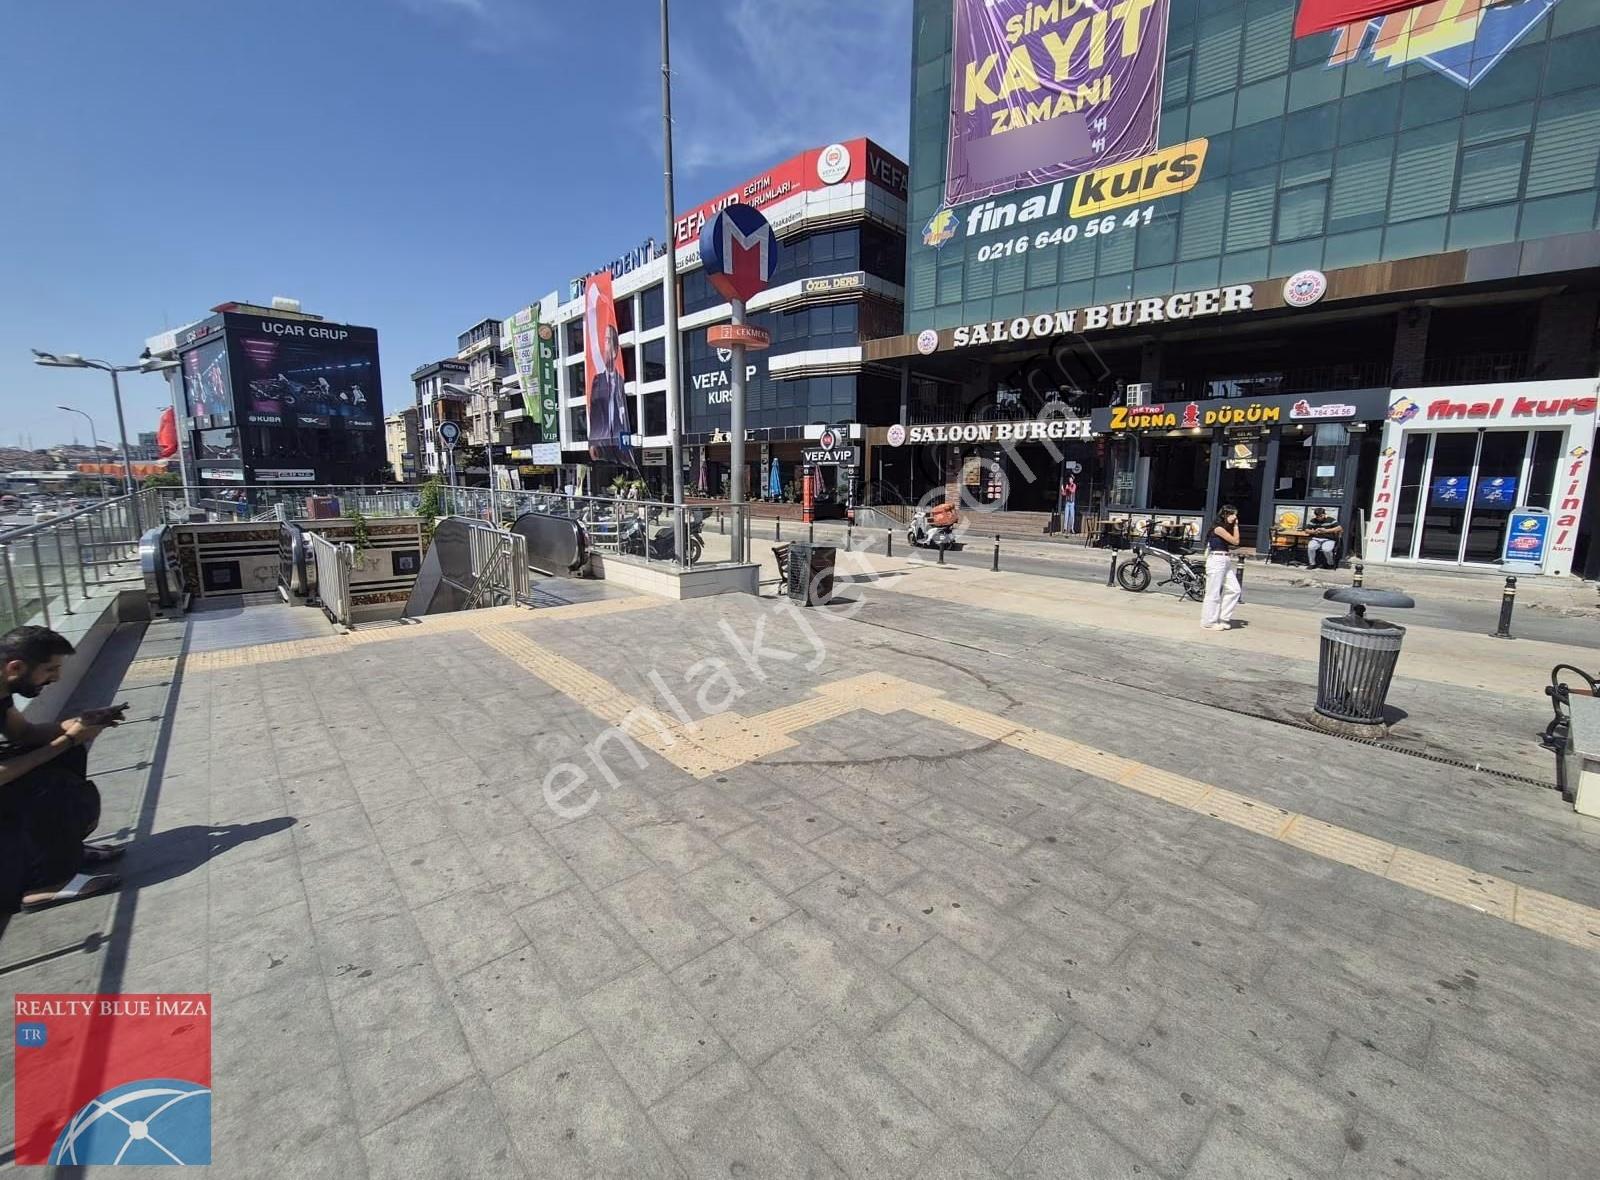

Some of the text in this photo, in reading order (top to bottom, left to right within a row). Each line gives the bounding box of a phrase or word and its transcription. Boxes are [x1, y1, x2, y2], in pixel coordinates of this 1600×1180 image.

[964, 0, 1154, 113] KAYIT
[991, 75, 1112, 136] ZAMANI
[744, 181, 792, 210] URUMLARI
[966, 152, 1199, 237] final kurs
[721, 210, 770, 282] M
[978, 206, 1154, 262] 0216 640 56 41
[806, 276, 859, 291] ÖZEL DERS
[262, 322, 348, 341] UÇAR GRUP
[953, 309, 1078, 348] SALOON
[1082, 285, 1255, 331] BURGER
[693, 370, 729, 390] VEFA
[1110, 403, 1280, 429] ZURNA DÜRÜM
[1426, 396, 1598, 420] final kurs
[910, 424, 993, 443] SALOON
[805, 451, 851, 461] VEFA VIP
[1374, 459, 1394, 534] final
[1556, 461, 1583, 545] final
